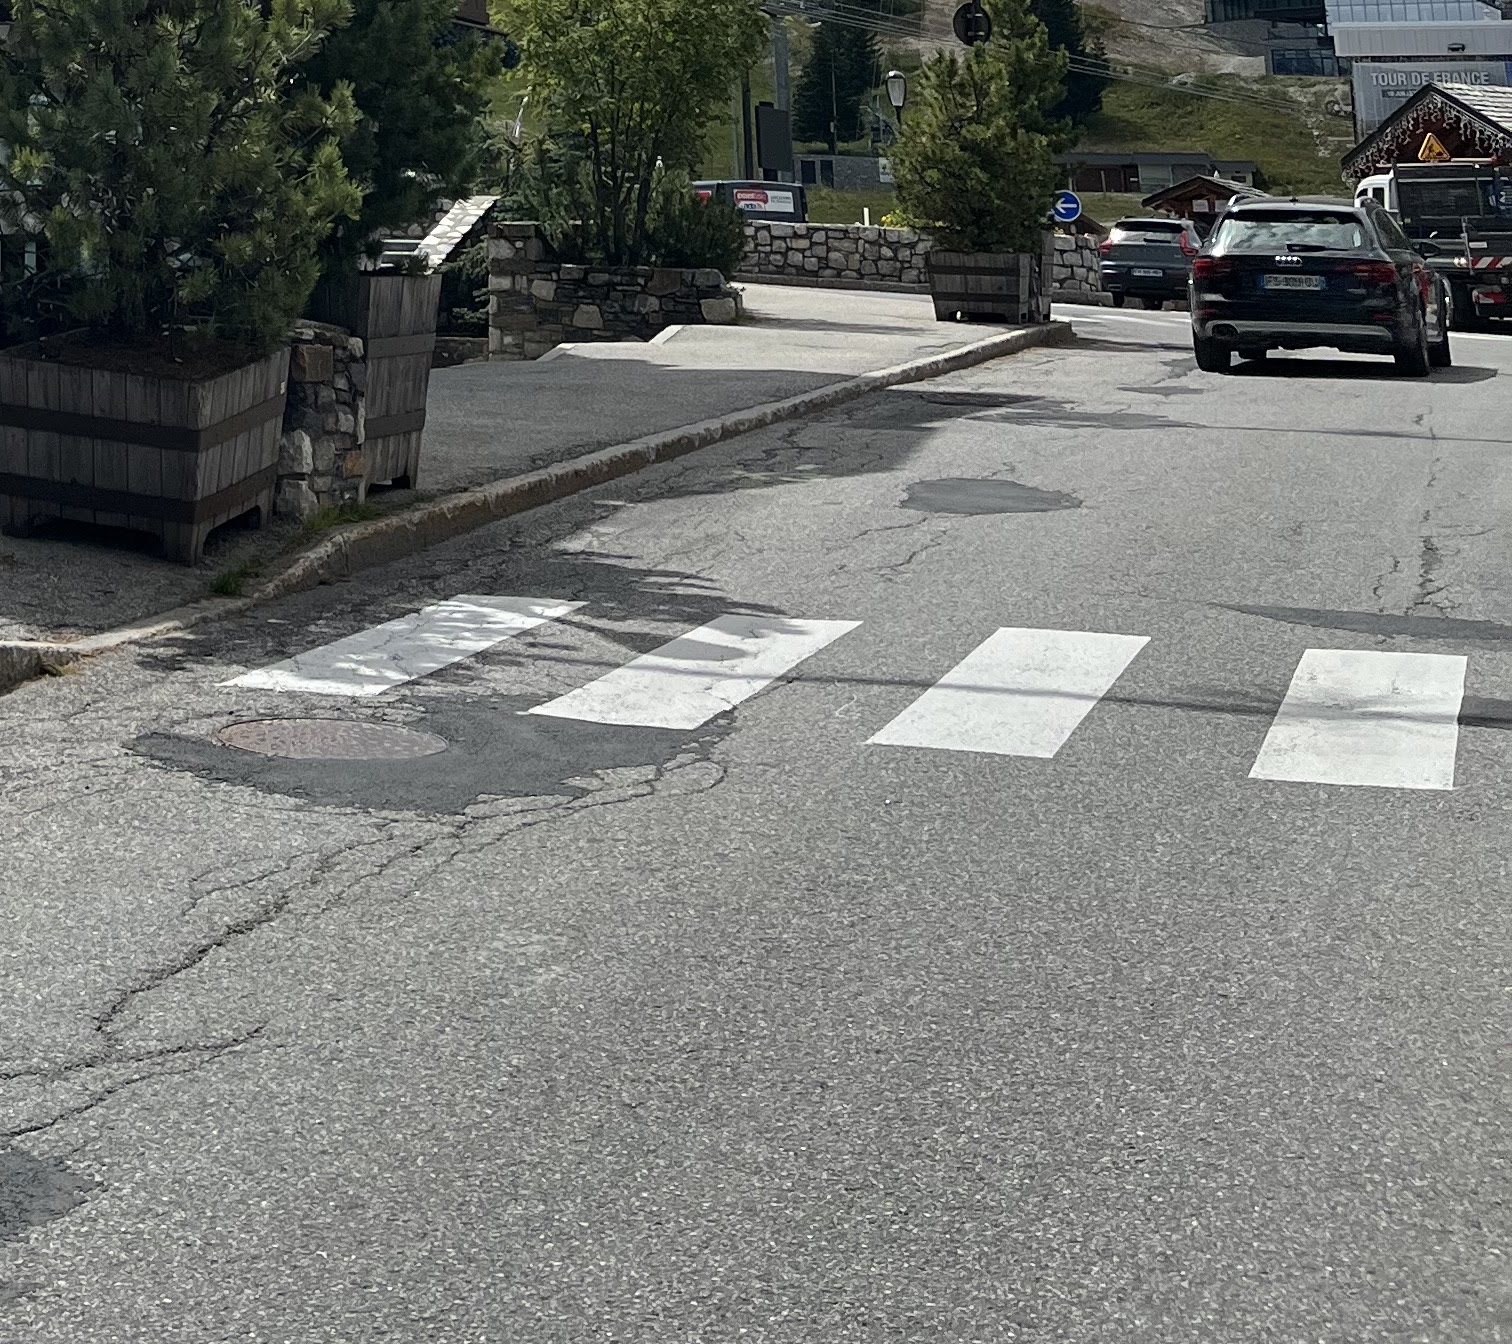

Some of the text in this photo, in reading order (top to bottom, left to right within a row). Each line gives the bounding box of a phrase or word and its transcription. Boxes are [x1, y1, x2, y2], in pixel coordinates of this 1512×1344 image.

[1371, 71, 1489, 86] TOUR DE FRANCE
